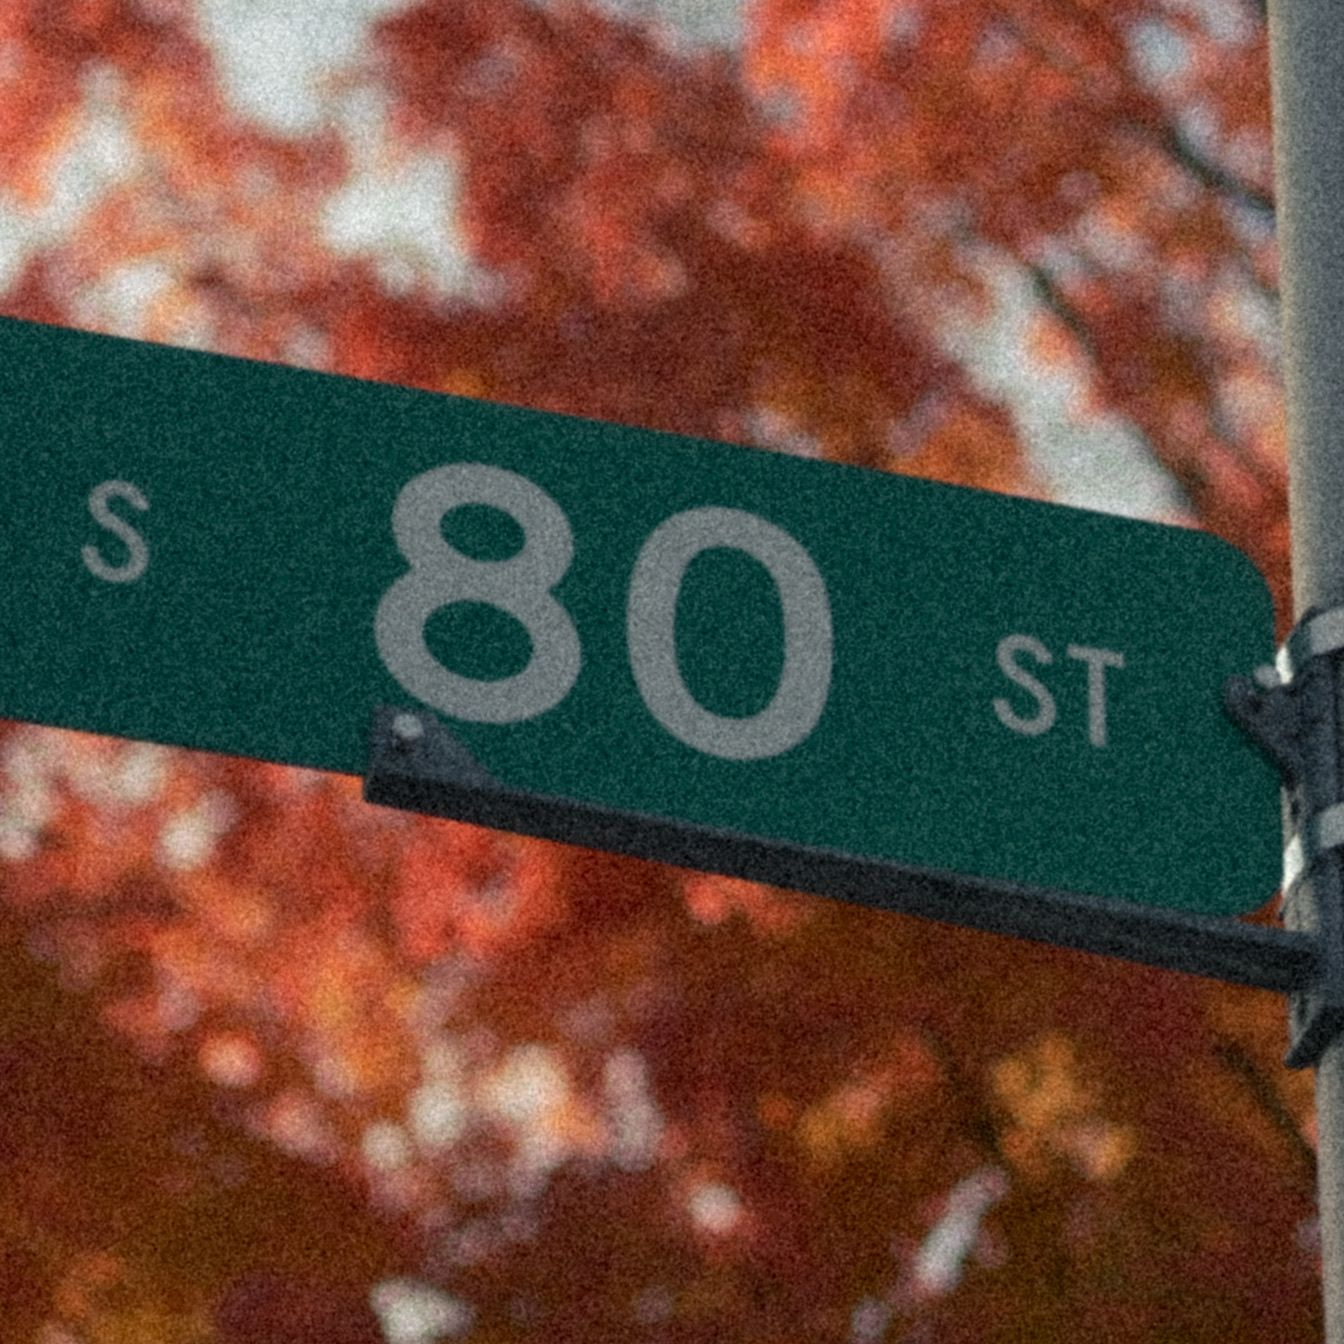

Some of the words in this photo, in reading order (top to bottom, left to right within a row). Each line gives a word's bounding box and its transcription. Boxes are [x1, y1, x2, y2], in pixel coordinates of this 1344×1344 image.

[81, 480, 149, 582] S
[374, 462, 834, 761] 80
[993, 633, 1125, 747] ST
